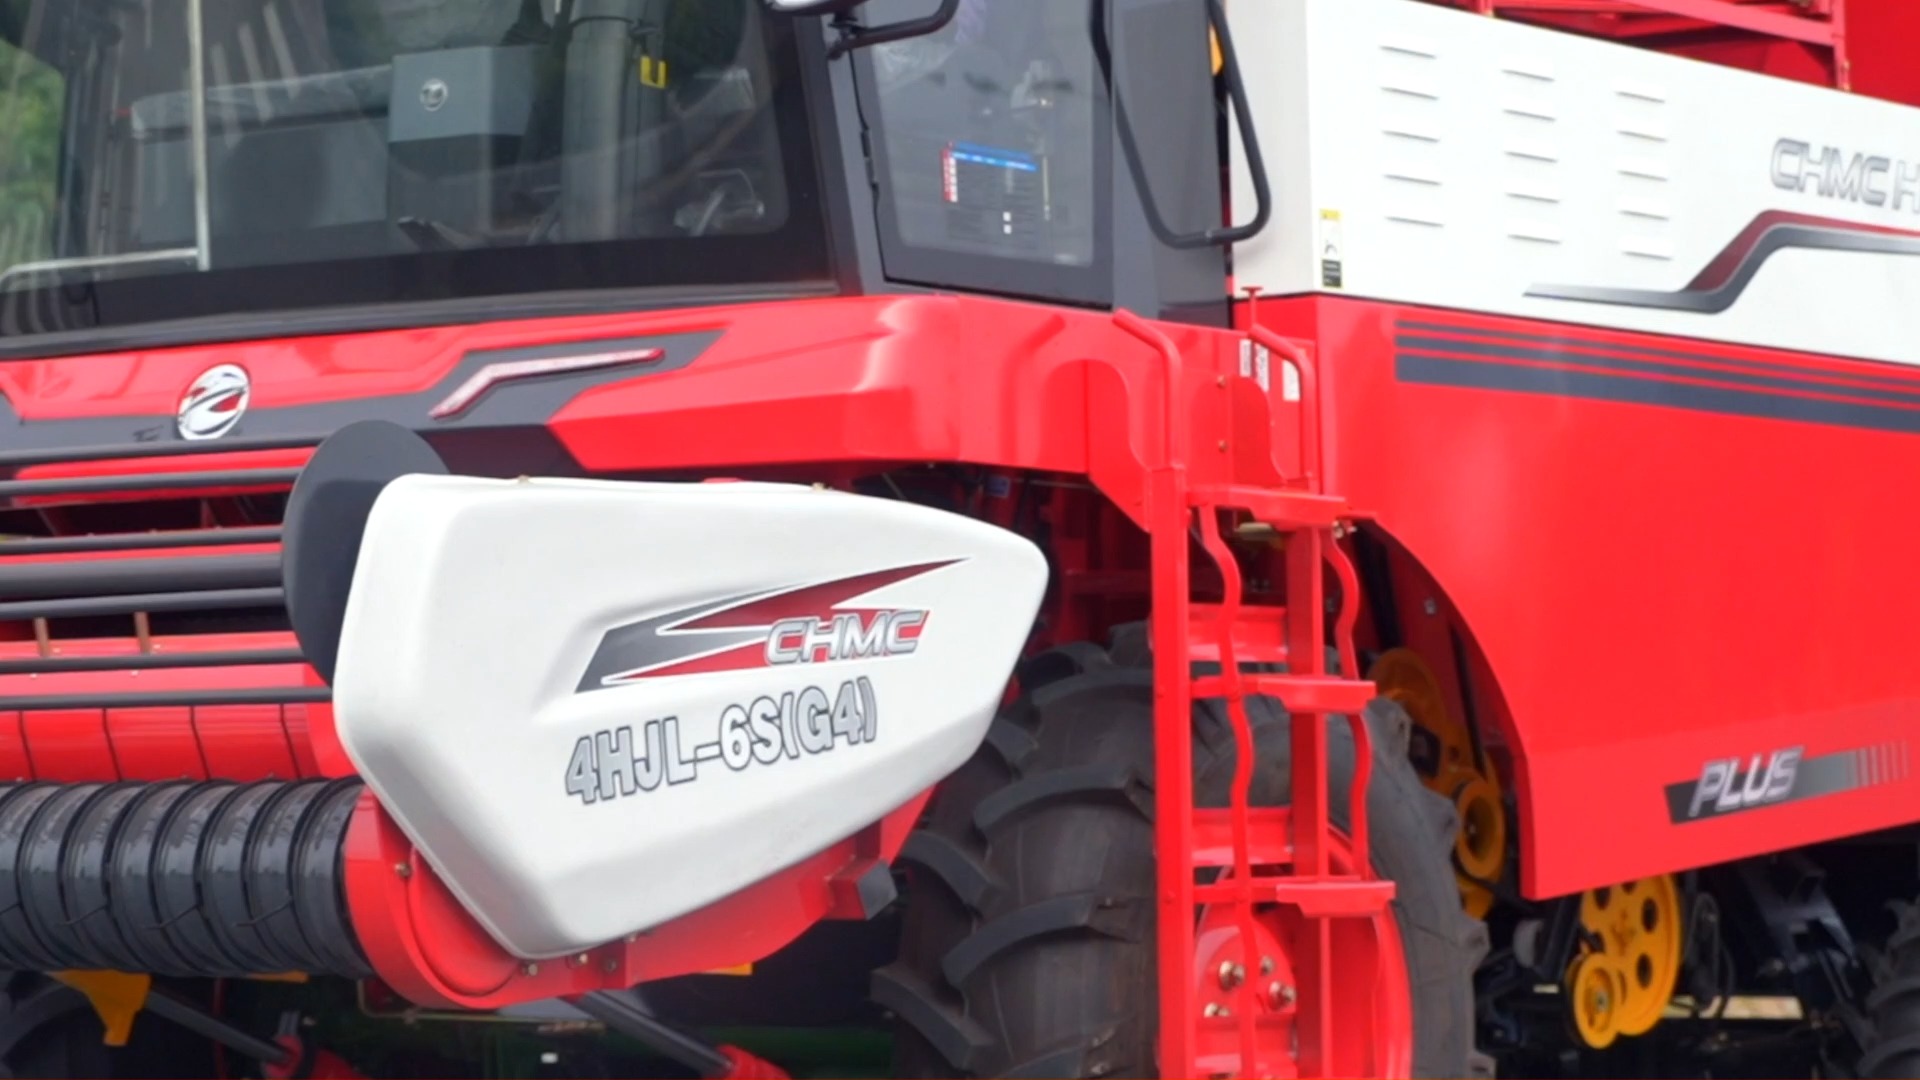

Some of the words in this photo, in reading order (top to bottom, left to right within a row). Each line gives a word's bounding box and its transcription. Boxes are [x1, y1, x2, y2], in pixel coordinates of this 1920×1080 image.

[1771, 138, 1891, 207] CHMC
[764, 609, 924, 665] CHMC
[565, 675, 877, 804] 4HJL-6S(G4)
[1687, 744, 1806, 818] PLUS
